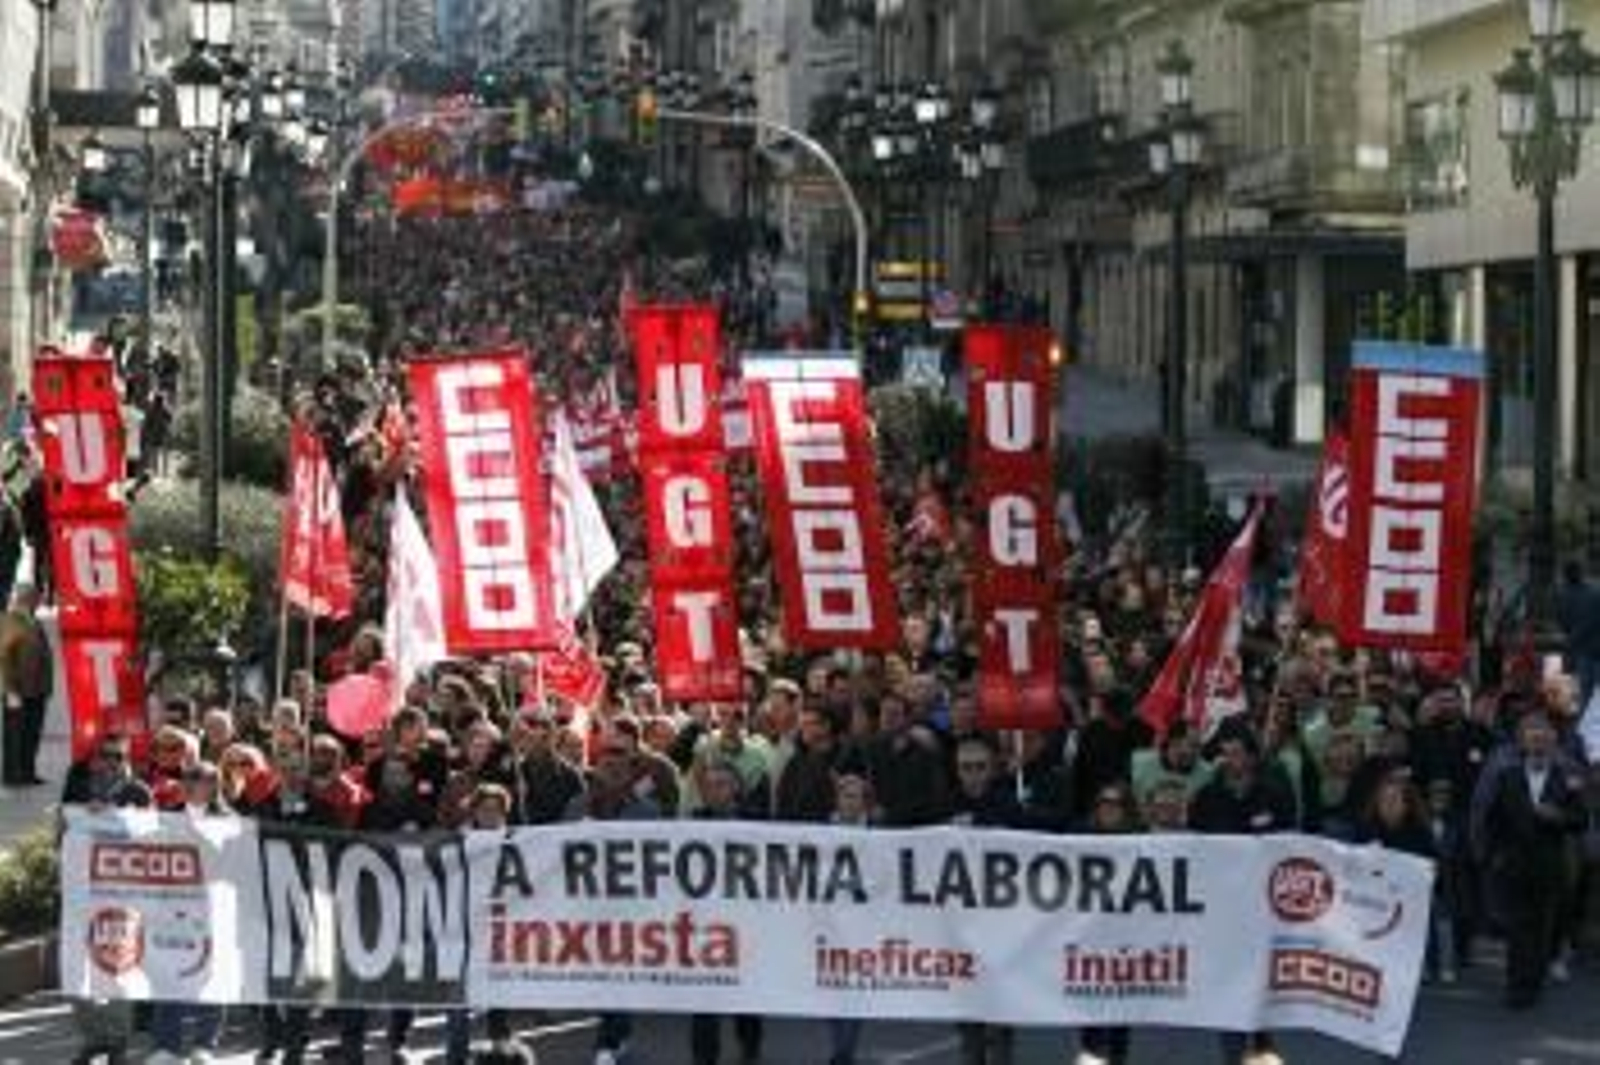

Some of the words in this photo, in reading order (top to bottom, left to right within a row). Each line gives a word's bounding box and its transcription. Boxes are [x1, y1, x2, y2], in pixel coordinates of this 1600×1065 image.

[56, 413, 124, 707] UGT
[434, 363, 537, 630] CCOO
[656, 363, 720, 662] UGT
[767, 381, 873, 631] CCOO
[985, 381, 1039, 673] UGT
[1364, 373, 1450, 635] CCOO
[97, 851, 196, 877] CCOO
[262, 838, 466, 987] NON
[562, 840, 869, 905] REFORMA
[897, 848, 1206, 914] LABORAL
[489, 903, 739, 968] inxusta
[815, 934, 977, 979] ineficaz
[1277, 956, 1376, 1000] CCOO
